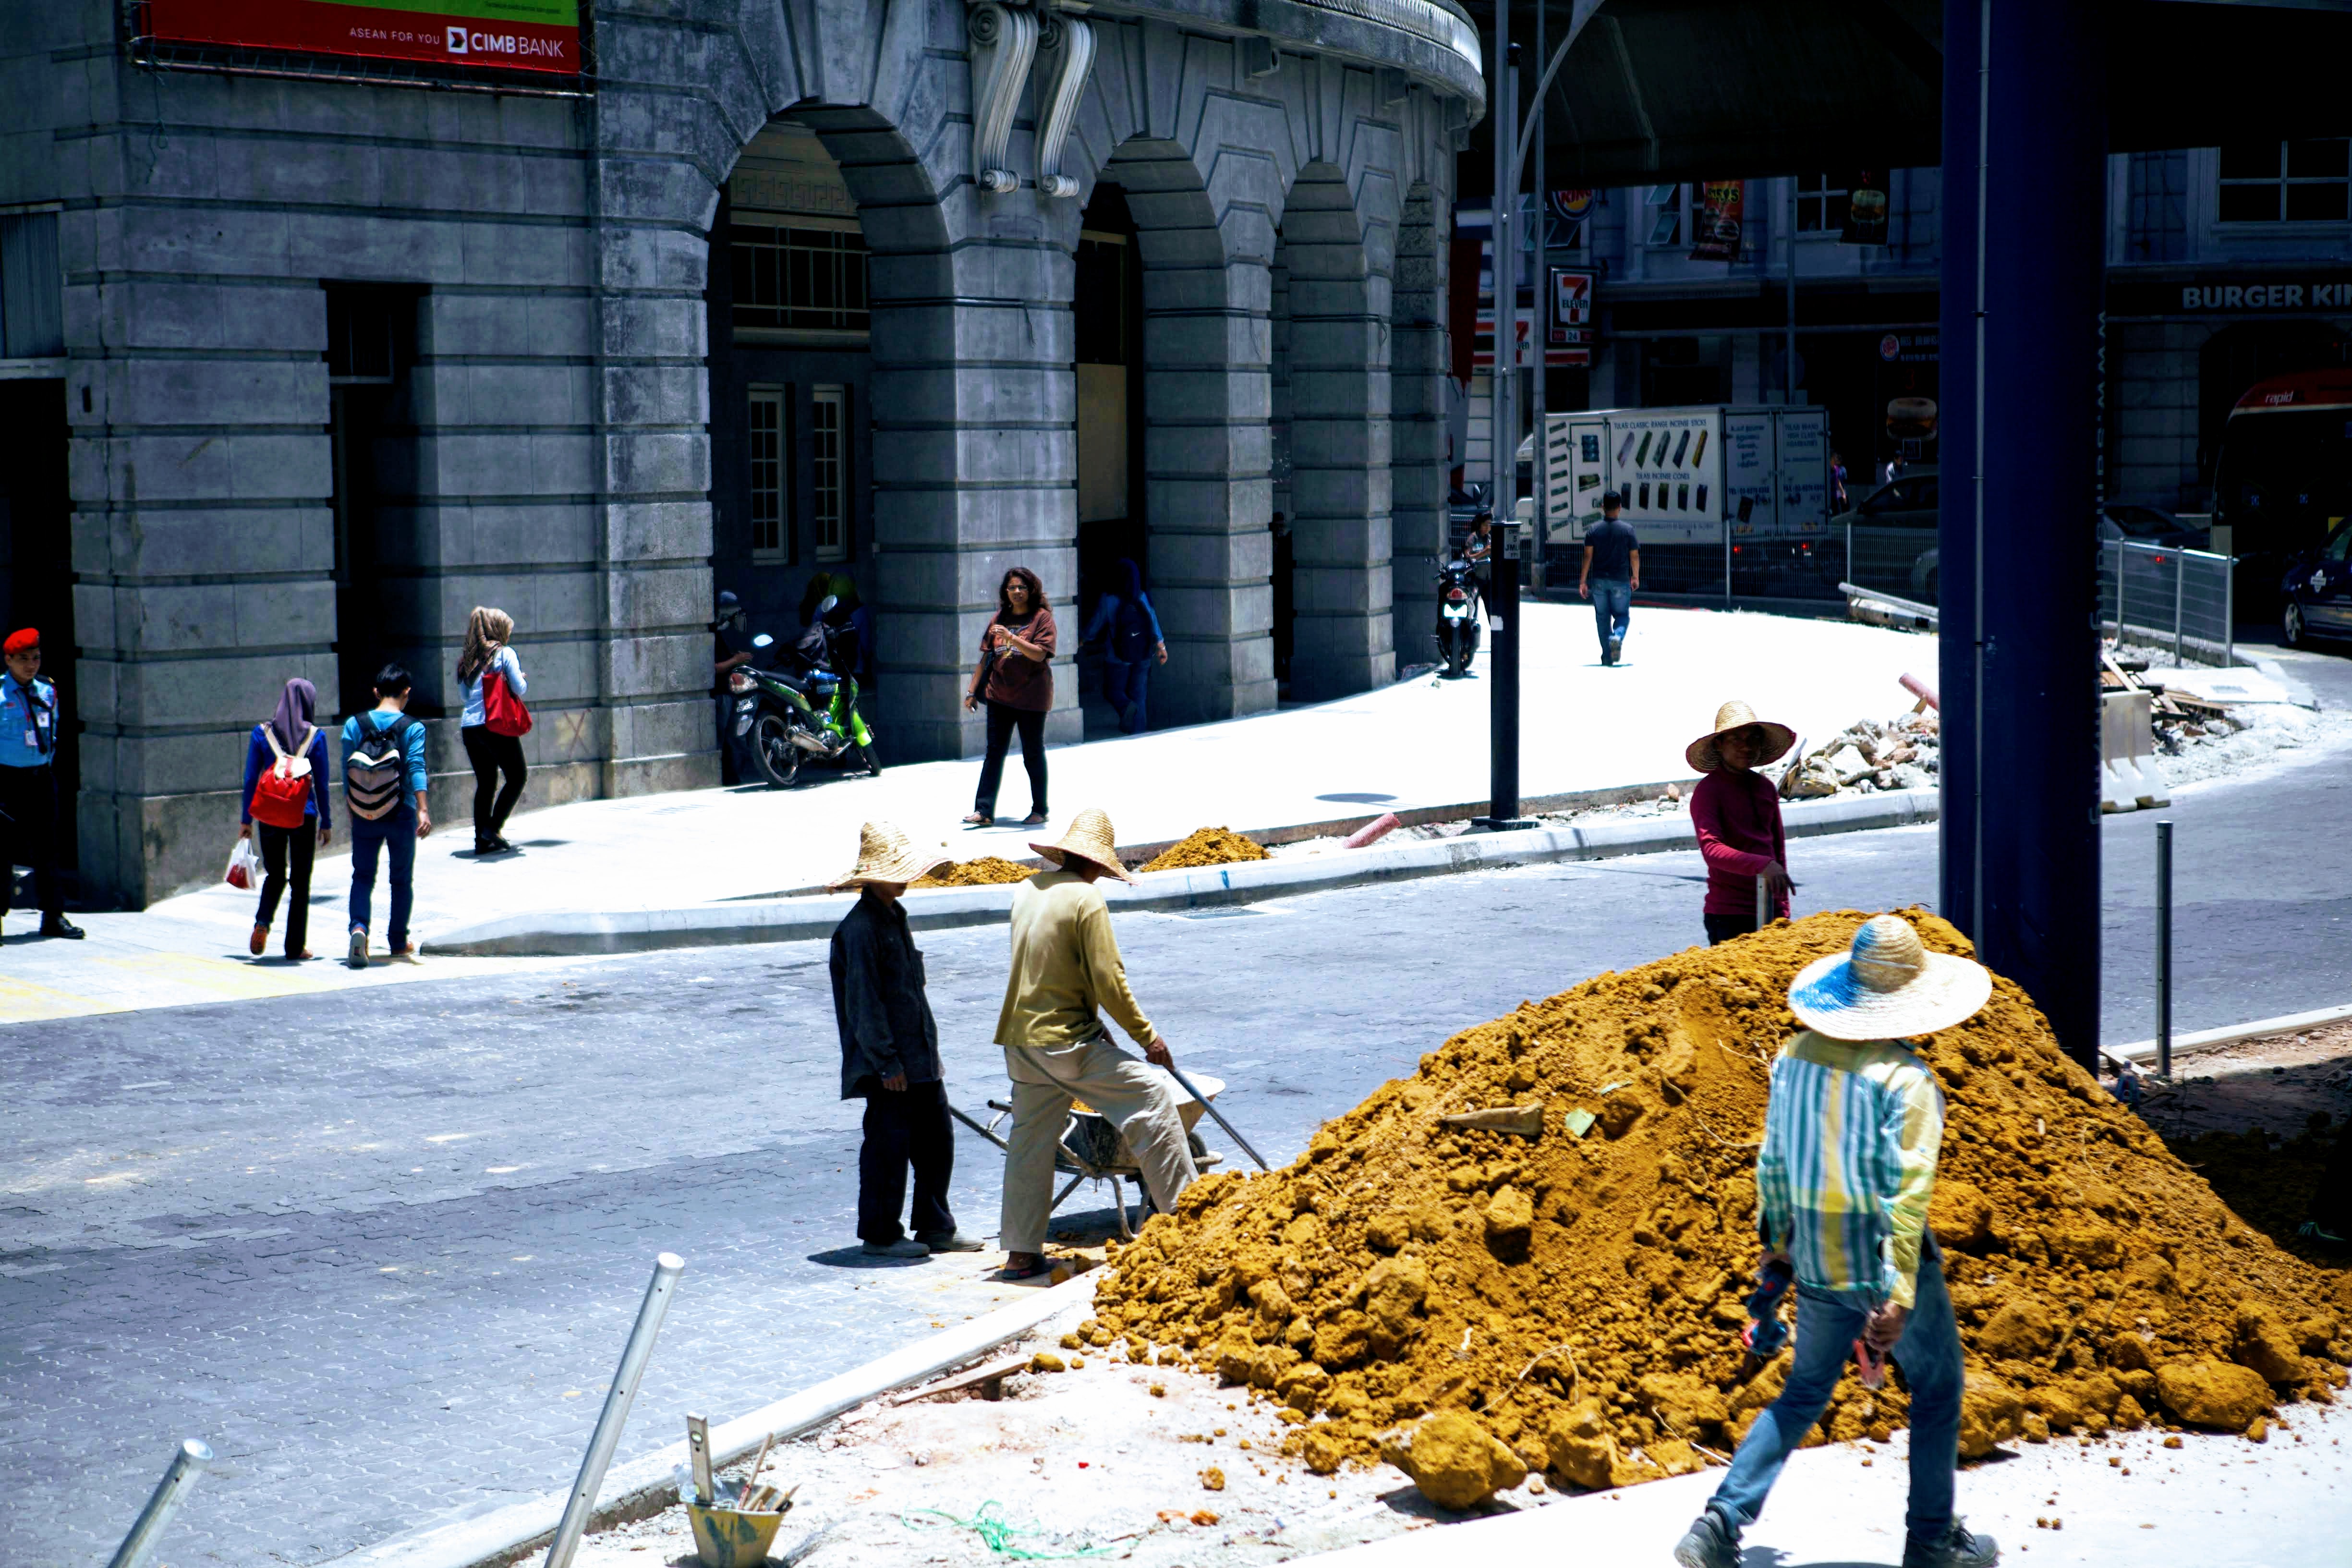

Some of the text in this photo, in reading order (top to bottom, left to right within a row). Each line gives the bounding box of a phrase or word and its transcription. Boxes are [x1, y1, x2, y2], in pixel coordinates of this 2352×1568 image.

[349, 27, 440, 45] ASEAN FOR YOU
[470, 32, 564, 58] CIMB BANK
[1563, 277, 1588, 322] 7
[2182, 284, 2304, 310] BURGER
[1568, 332, 1577, 340] 24
